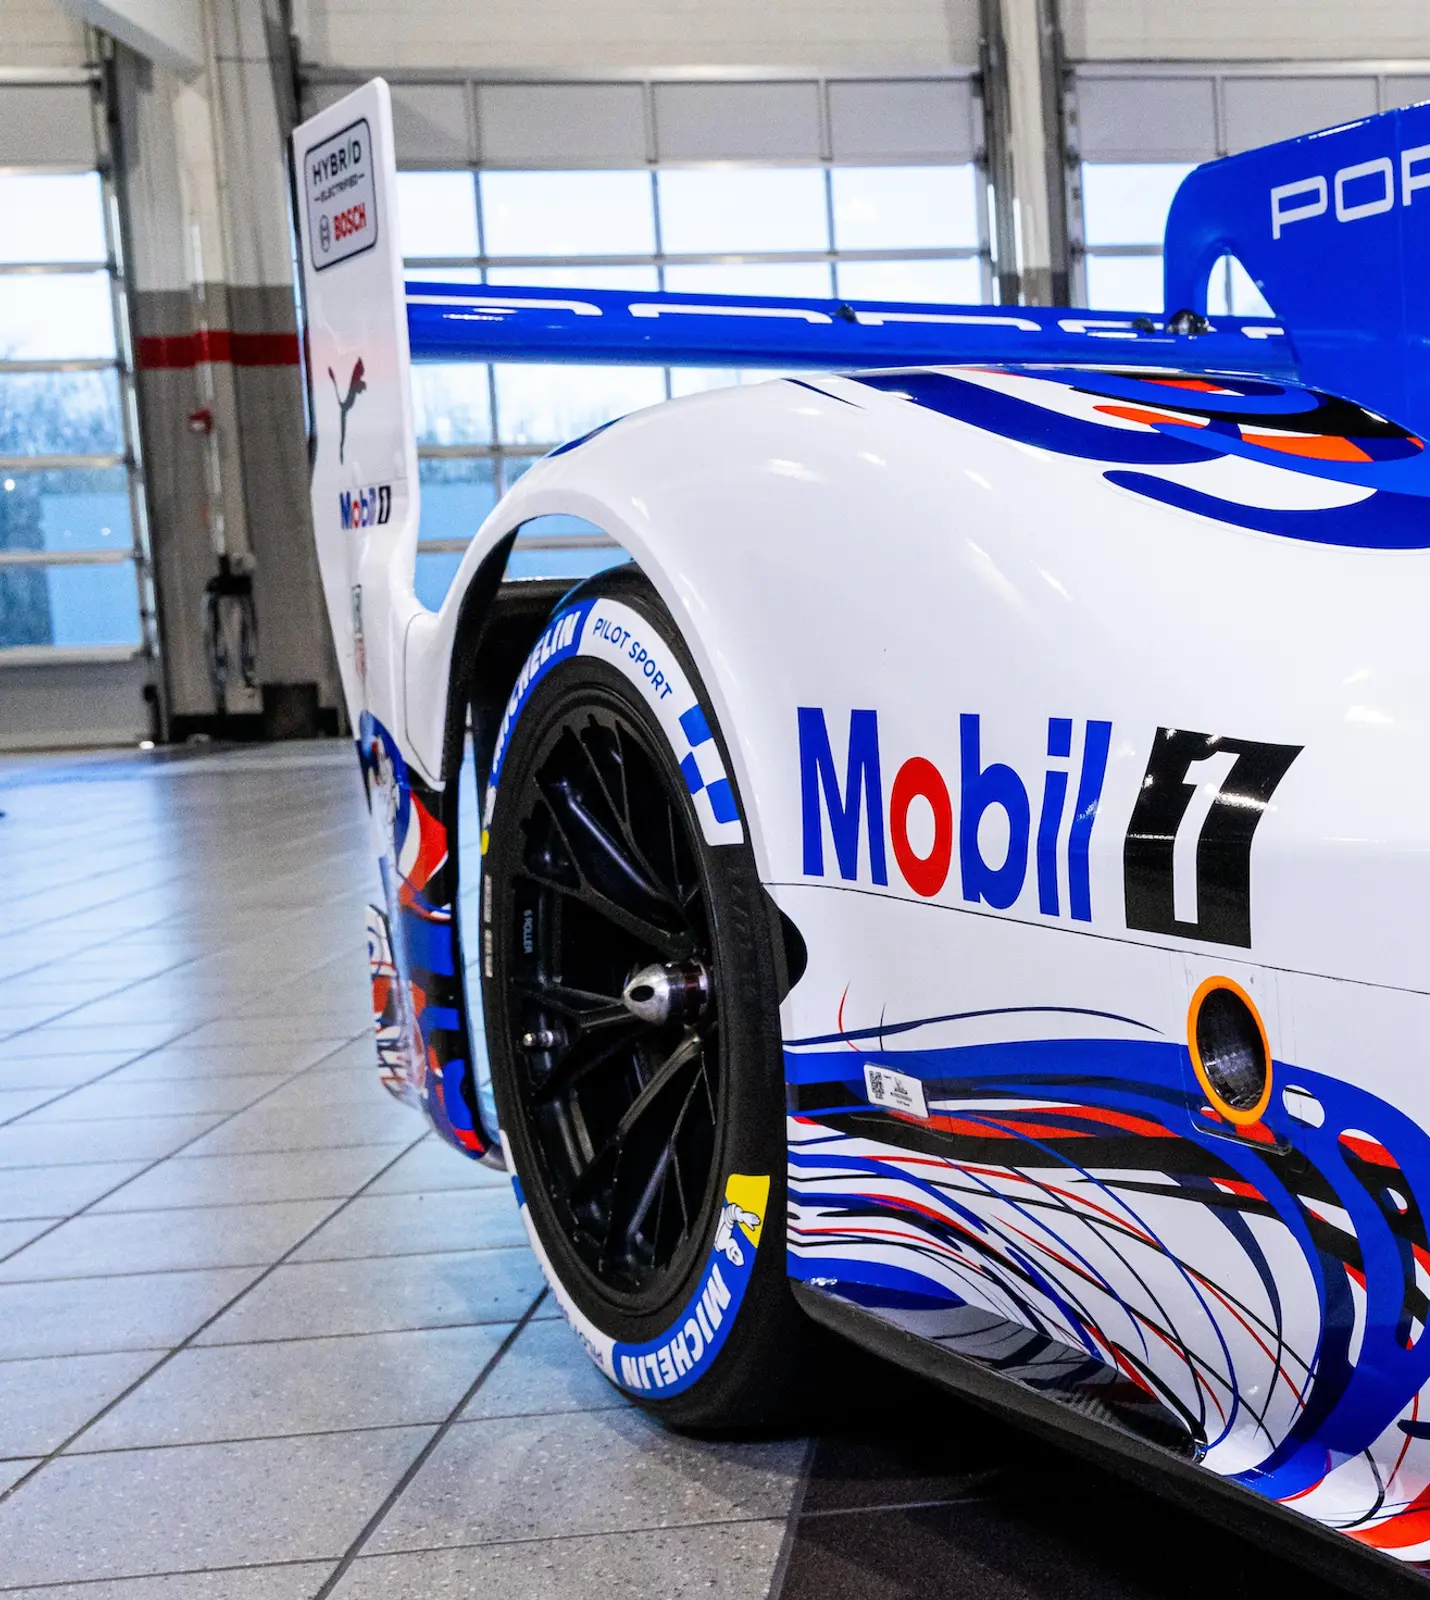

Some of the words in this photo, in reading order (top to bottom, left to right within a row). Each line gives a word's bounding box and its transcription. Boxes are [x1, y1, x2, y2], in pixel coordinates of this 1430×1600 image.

[312, 138, 362, 186] HYBRID
[333, 202, 367, 241] BOSCH
[592, 617, 631, 649] PILOT
[628, 641, 673, 700] SPORT
[797, 706, 1112, 923] Mobil
[620, 1262, 732, 1390] MICHELIN
